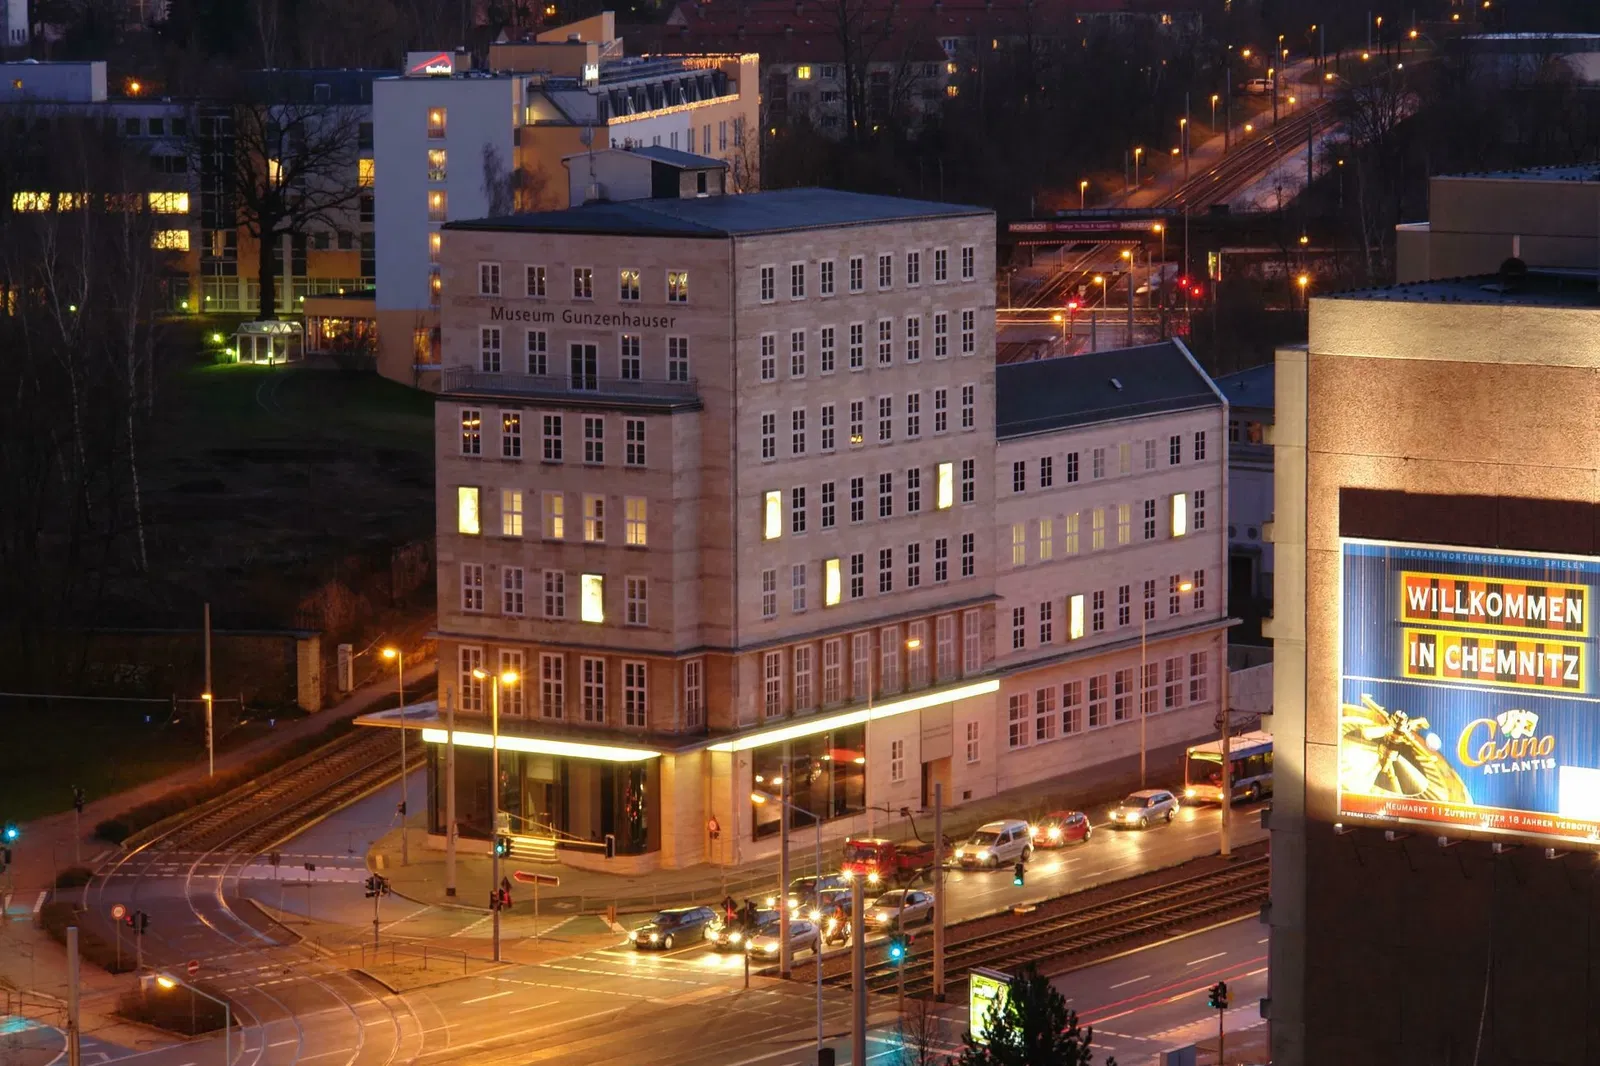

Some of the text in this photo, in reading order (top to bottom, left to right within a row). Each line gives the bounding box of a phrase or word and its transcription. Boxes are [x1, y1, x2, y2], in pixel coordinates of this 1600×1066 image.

[490, 306, 677, 329] Museum Gunzenhauser
[1404, 549, 1586, 570] VERANTWORTUNGSBEWUSST SPIELEN
[1407, 585, 1583, 624] WILLKOMMEN
[1409, 641, 1580, 681] IN CHEMNITZ
[1457, 718, 1555, 767] Casino
[1483, 758, 1557, 775] ATLANTIS
[1508, 815, 1519, 824] 18
[1521, 817, 1553, 828] JAHREN
